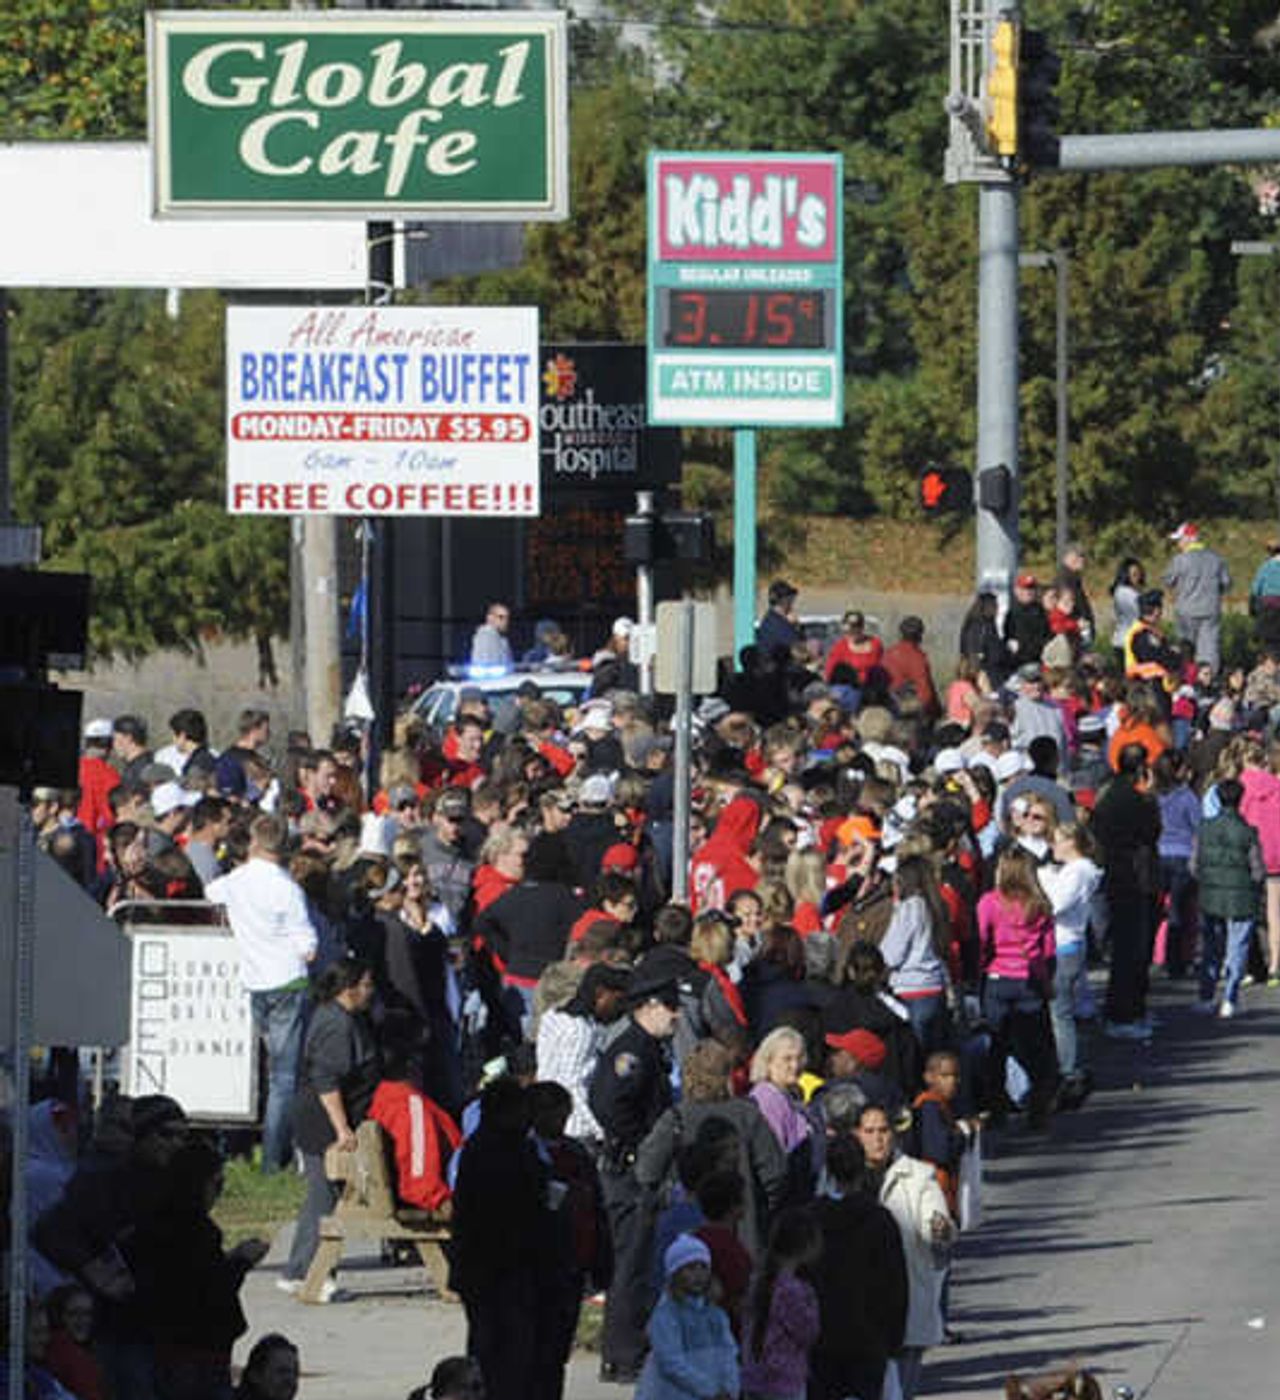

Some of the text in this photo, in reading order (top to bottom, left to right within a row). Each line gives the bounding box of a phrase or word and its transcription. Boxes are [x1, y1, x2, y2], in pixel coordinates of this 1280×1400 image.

[182, 39, 532, 109] Global
[239, 108, 479, 198] Cafe
[664, 172, 827, 249] Kidd's
[288, 310, 478, 349] All American
[240, 352, 531, 404] BREAKFAST BUFFET
[671, 370, 822, 392] ATM INSIDE
[238, 415, 526, 441] MONDAY-FRIDAY $5.95
[541, 387, 646, 431] outheast
[395, 448, 459, 471] 10am
[233, 482, 534, 511] FREE COFFEE!!!
